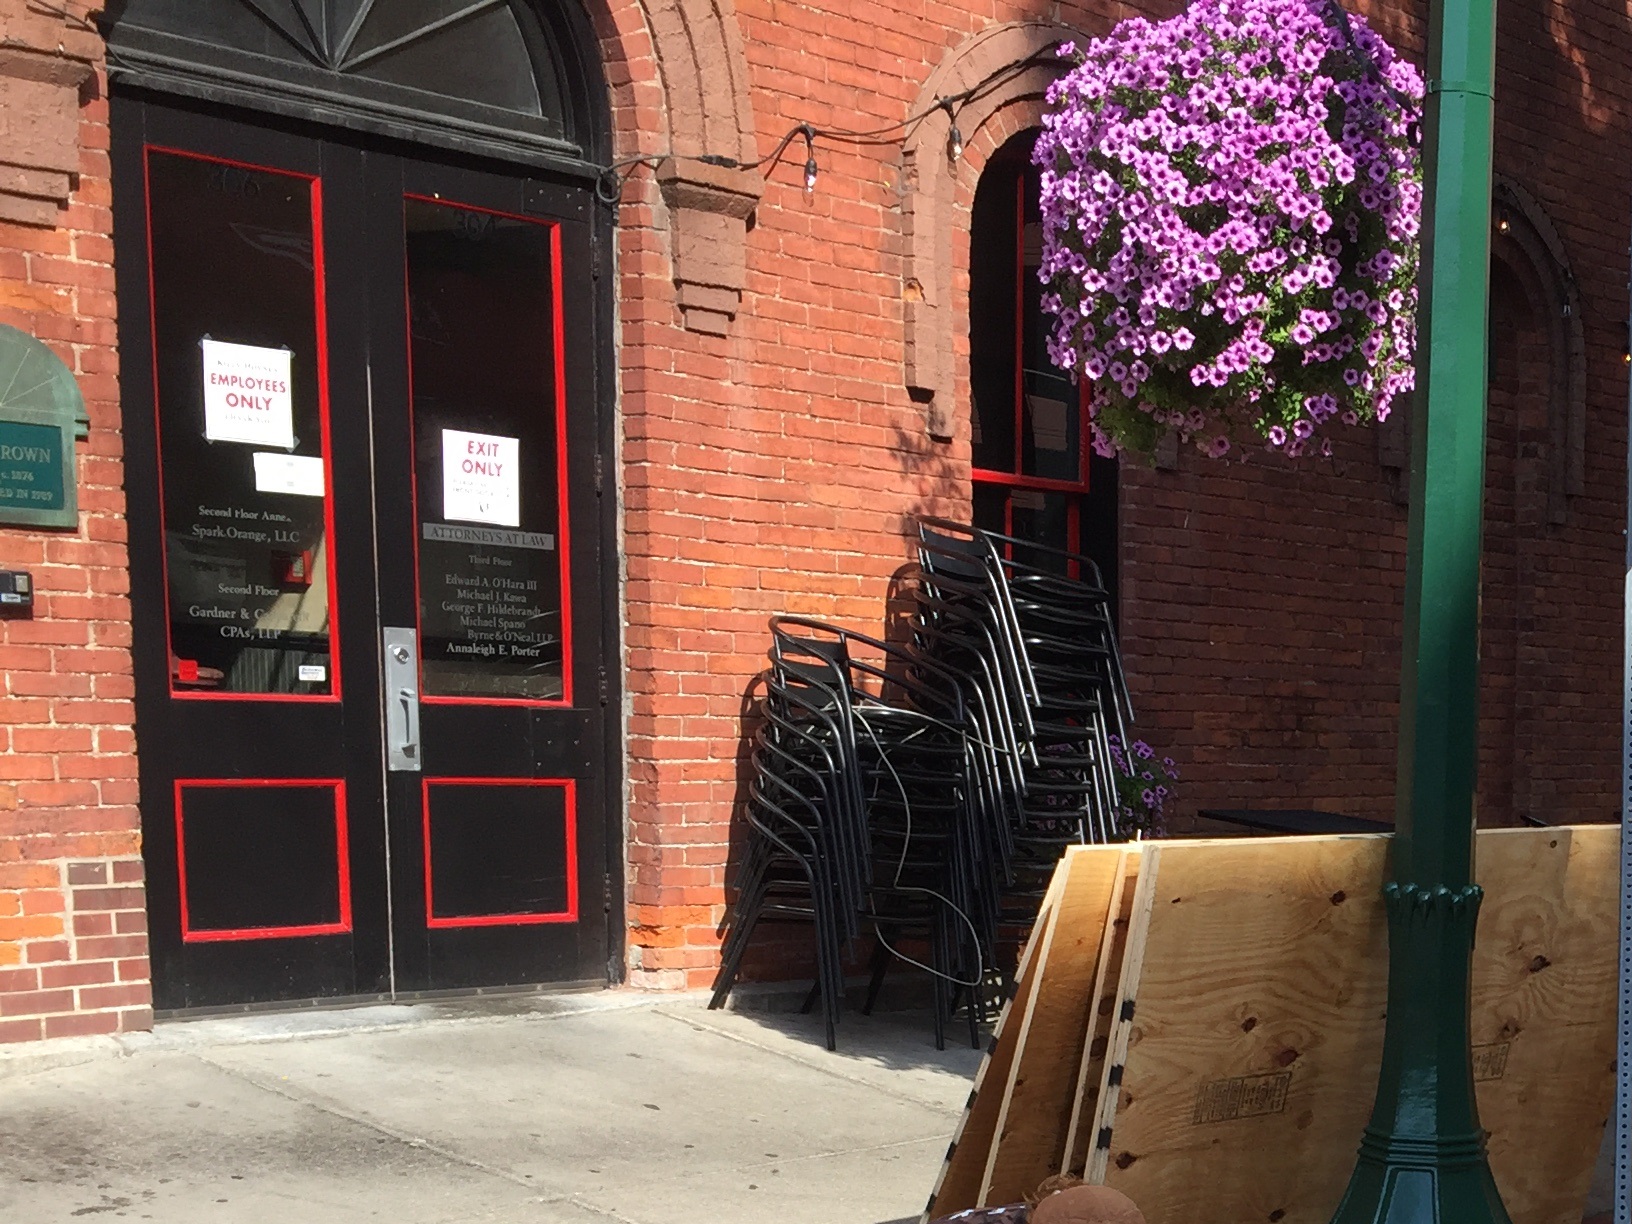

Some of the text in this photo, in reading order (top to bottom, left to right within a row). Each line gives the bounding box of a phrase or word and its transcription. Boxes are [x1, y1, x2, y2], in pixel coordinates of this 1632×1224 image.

[210, 372, 286, 393] EMPLOYEES
[226, 392, 272, 411] ONLY
[467, 440, 499, 457] EXIT
[461, 459, 503, 477] ONLY
[16, 488, 28, 500] IN
[198, 505, 232, 518] Second
[192, 523, 300, 543] Spark Orange, LLC
[430, 526, 546, 547] ATTORNEYS AT LAW
[469, 554, 513, 567] Third Floor
[218, 582, 279, 597] Second Floor
[445, 573, 480, 588] Edward
[492, 577, 525, 590] O'Hara
[526, 580, 537, 591] III
[457, 588, 494, 601] Michael
[503, 591, 527, 604] Kawa
[189, 605, 236, 620] Gardner
[240, 607, 250, 620] &
[441, 600, 475, 616] George
[460, 615, 526, 631] Michael Spano
[220, 625, 255, 641] CPAs,
[467, 629, 495, 643] Byrne
[494, 631, 504, 642] &
[446, 642, 541, 658] Annaleigh E. Porter
